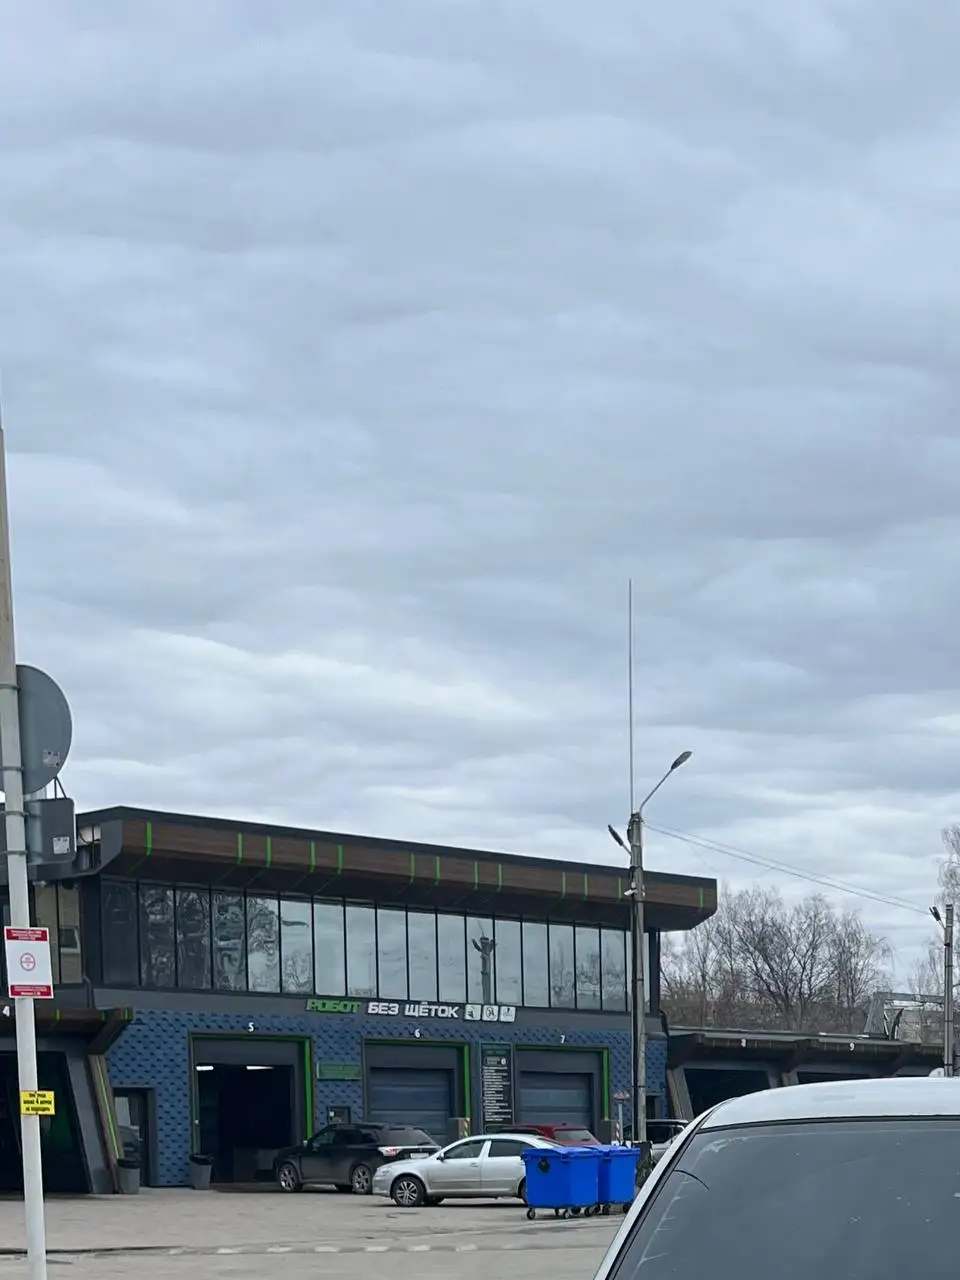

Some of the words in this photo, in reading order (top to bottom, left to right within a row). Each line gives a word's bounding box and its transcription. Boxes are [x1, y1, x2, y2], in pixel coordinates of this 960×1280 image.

[2, 1005, 10, 1017] 4
[306, 999, 361, 1013] РОБОТ
[367, 1002, 399, 1015] БЕЗ
[404, 1001, 460, 1018] ЩЁТОК
[247, 1022, 254, 1033] 5
[414, 1028, 421, 1038] 6
[559, 1034, 566, 1044] 7
